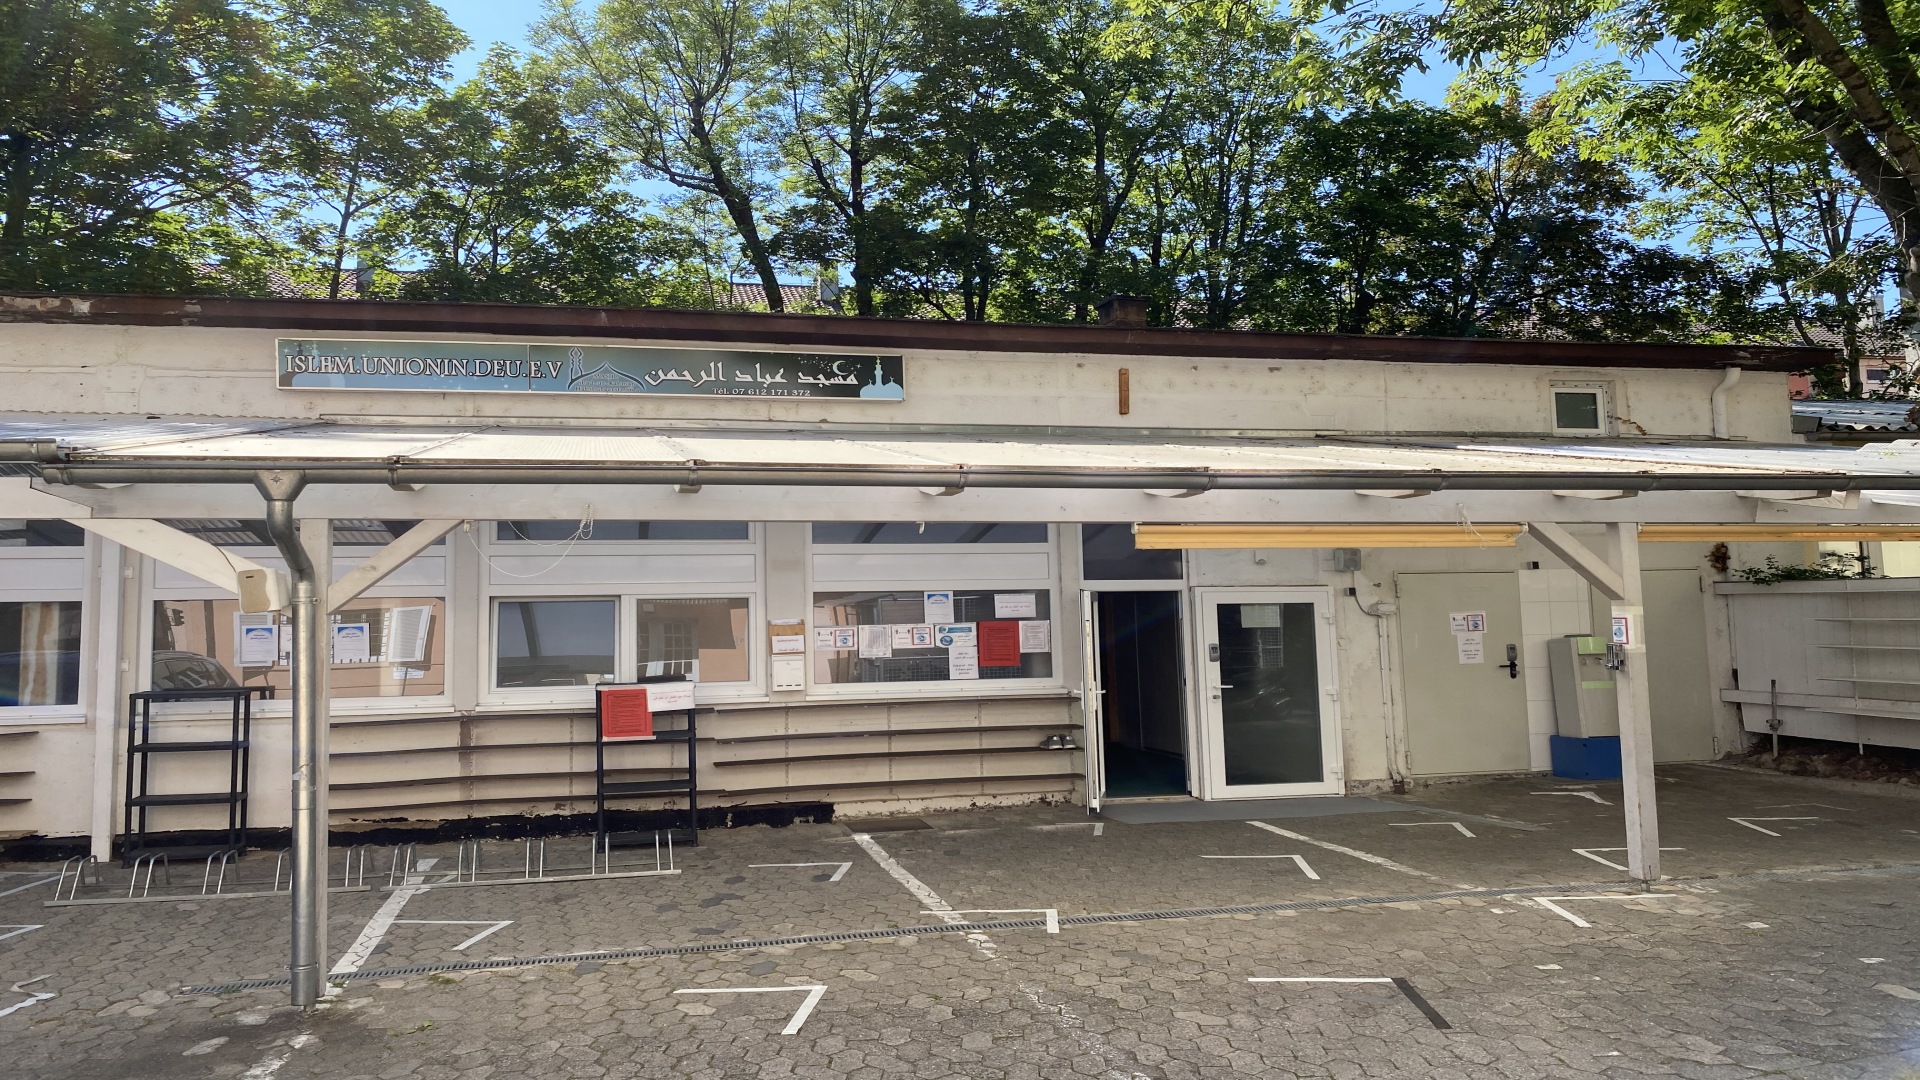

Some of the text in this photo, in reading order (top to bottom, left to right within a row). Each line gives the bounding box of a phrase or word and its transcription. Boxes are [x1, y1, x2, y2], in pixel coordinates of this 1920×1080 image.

[643, 361, 859, 388] مسجد عباد الرحمن
[747, 388, 768, 396] 612
[791, 389, 811, 397] 372
